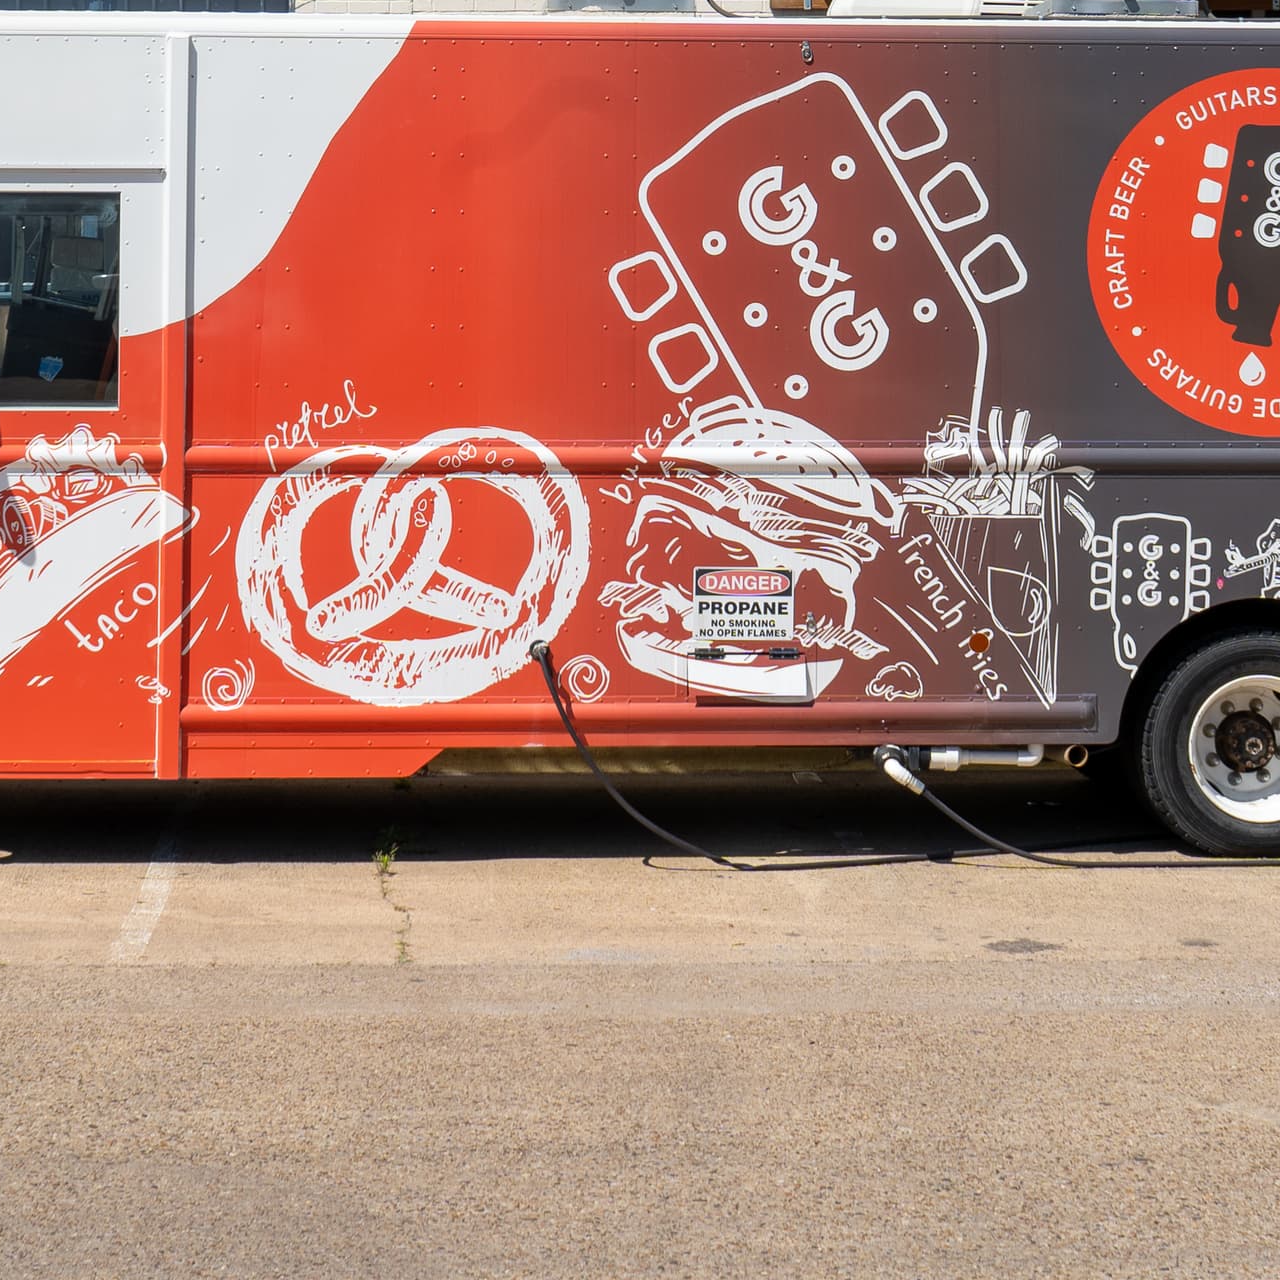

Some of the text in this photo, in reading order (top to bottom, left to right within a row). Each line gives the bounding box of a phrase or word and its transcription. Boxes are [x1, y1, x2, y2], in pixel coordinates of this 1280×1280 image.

[1175, 86, 1277, 130] GUITARS
[1105, 157, 1150, 310] CRAFT BEER
[1147, 348, 1242, 414] GUITARS
[705, 575, 782, 591] DANGER
[897, 533, 967, 629] french
[698, 601, 789, 615] PROPANE
[699, 628, 787, 638] NO OPEN FLAMES
[711, 619, 776, 628] NO SMOKING
